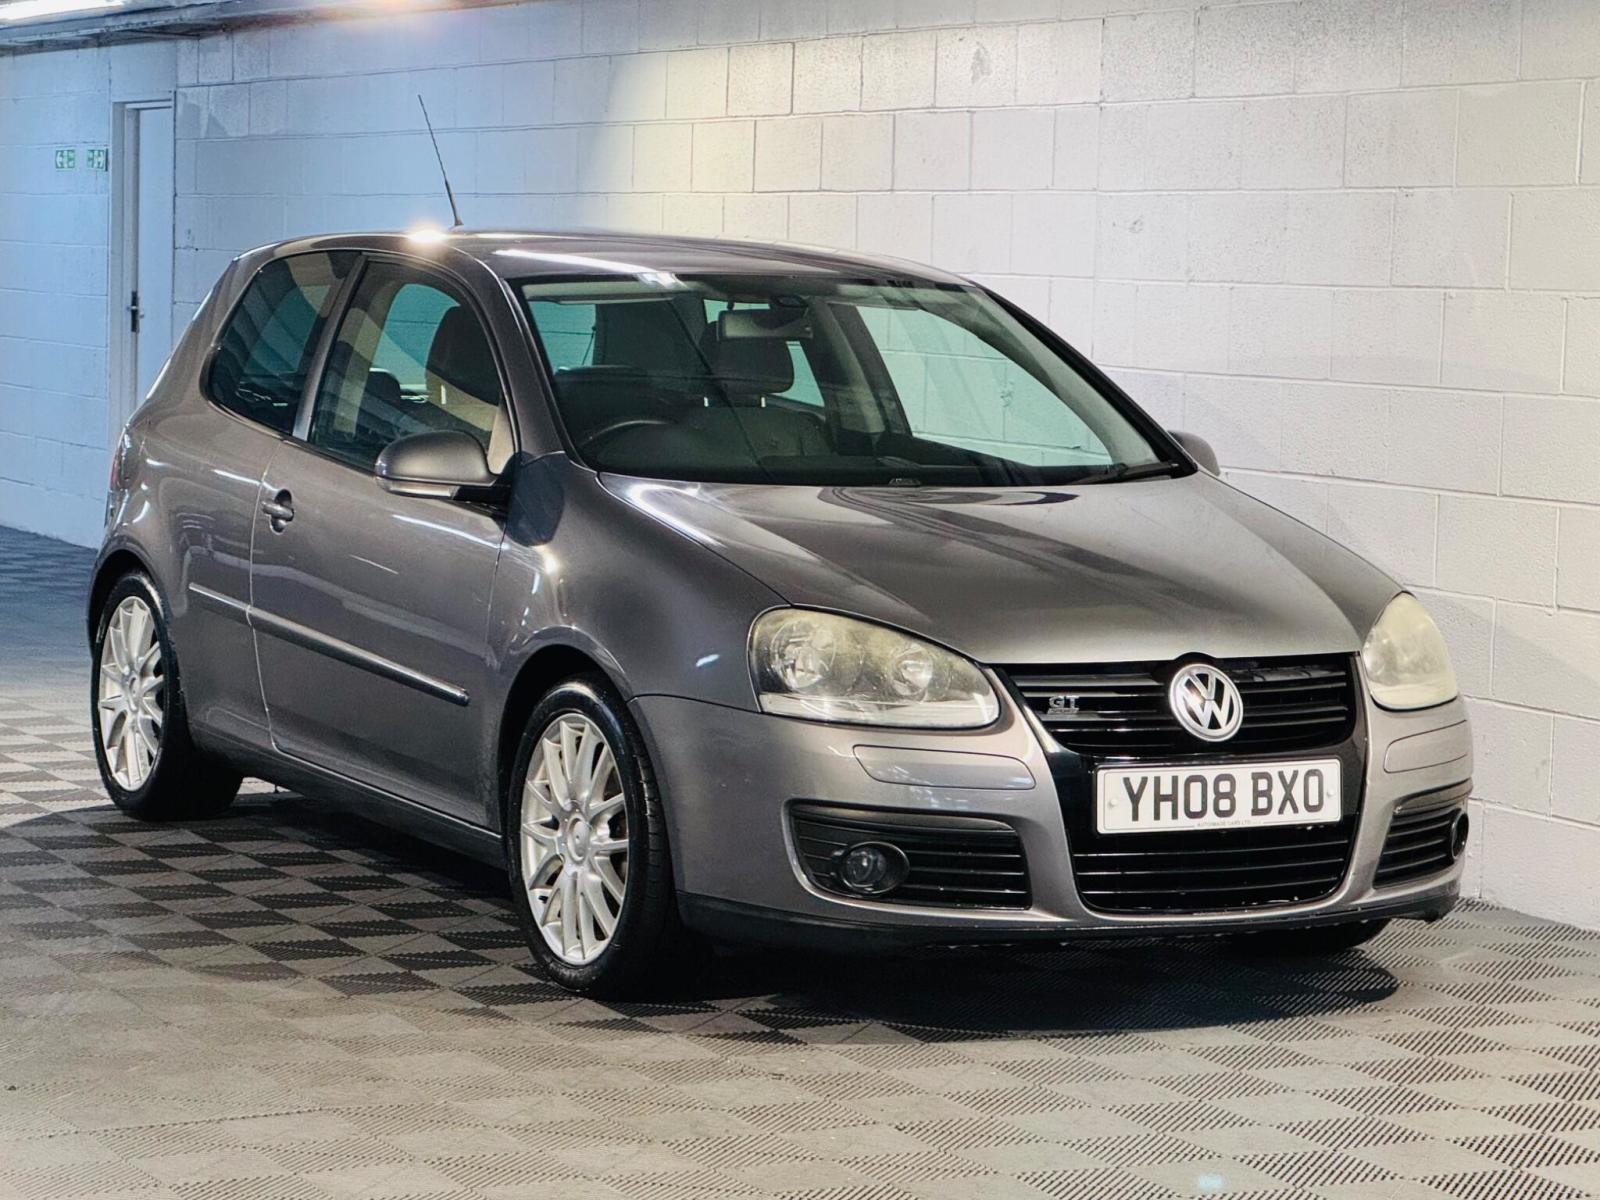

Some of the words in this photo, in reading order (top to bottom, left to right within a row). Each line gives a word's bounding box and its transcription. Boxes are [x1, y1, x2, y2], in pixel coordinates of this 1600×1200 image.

[1049, 695, 1080, 709] GT
[1123, 773, 1237, 822] YH08
[1251, 768, 1324, 816] BXO
